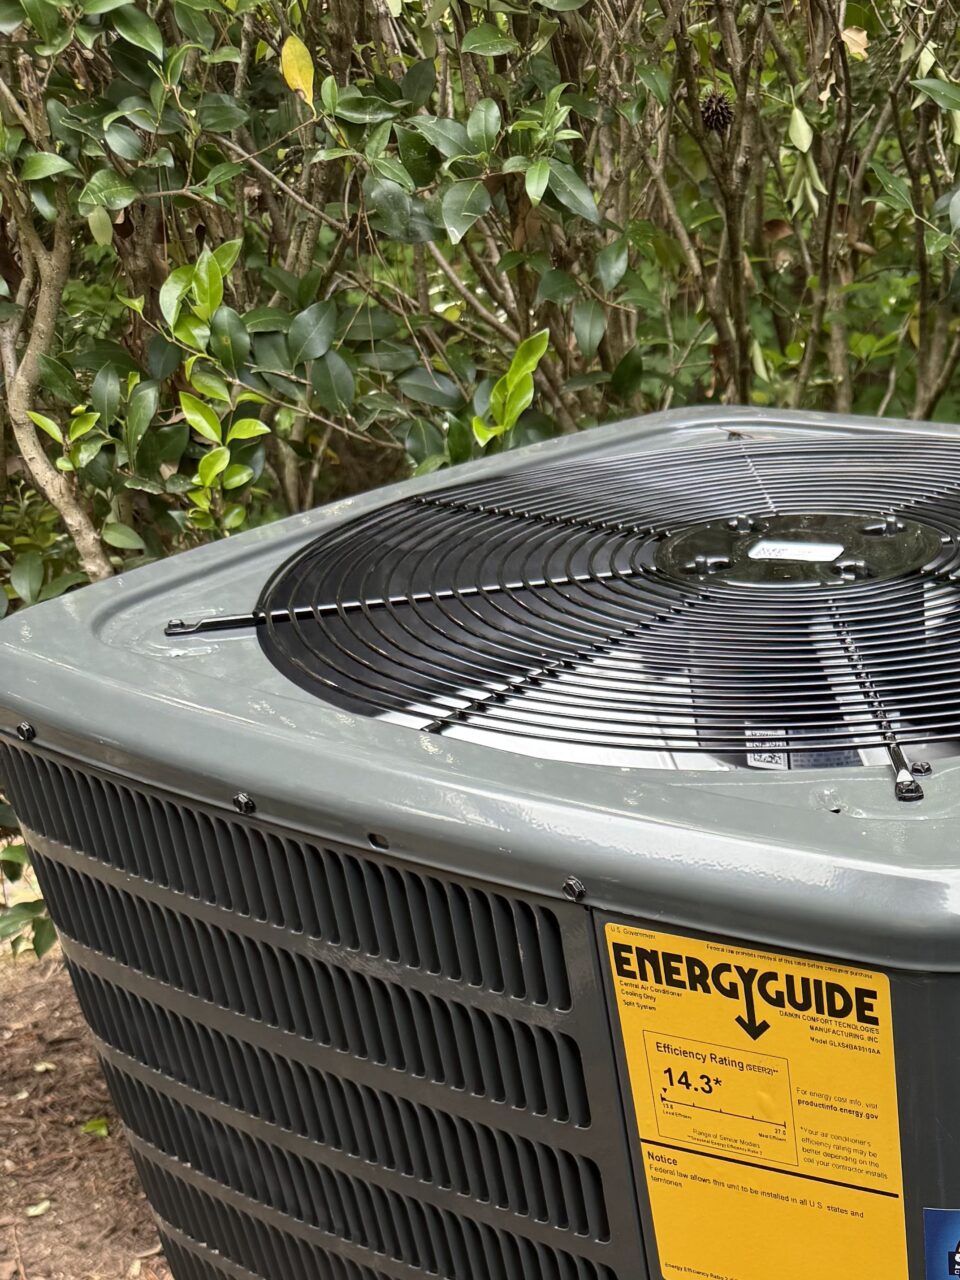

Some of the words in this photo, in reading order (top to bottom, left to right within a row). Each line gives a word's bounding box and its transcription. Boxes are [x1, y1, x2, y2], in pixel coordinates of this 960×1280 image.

[612, 942, 880, 1027] ENERGYGUIDE
[656, 1042, 707, 1063] Efficiency
[710, 1053, 744, 1071] Rating
[648, 1151, 678, 1166] Notice
[650, 1164, 675, 1176] Federal
[677, 1170, 689, 1179] law
[690, 1173, 711, 1185] allows
[750, 1187, 759, 1195] be
[850, 1209, 864, 1218] and
